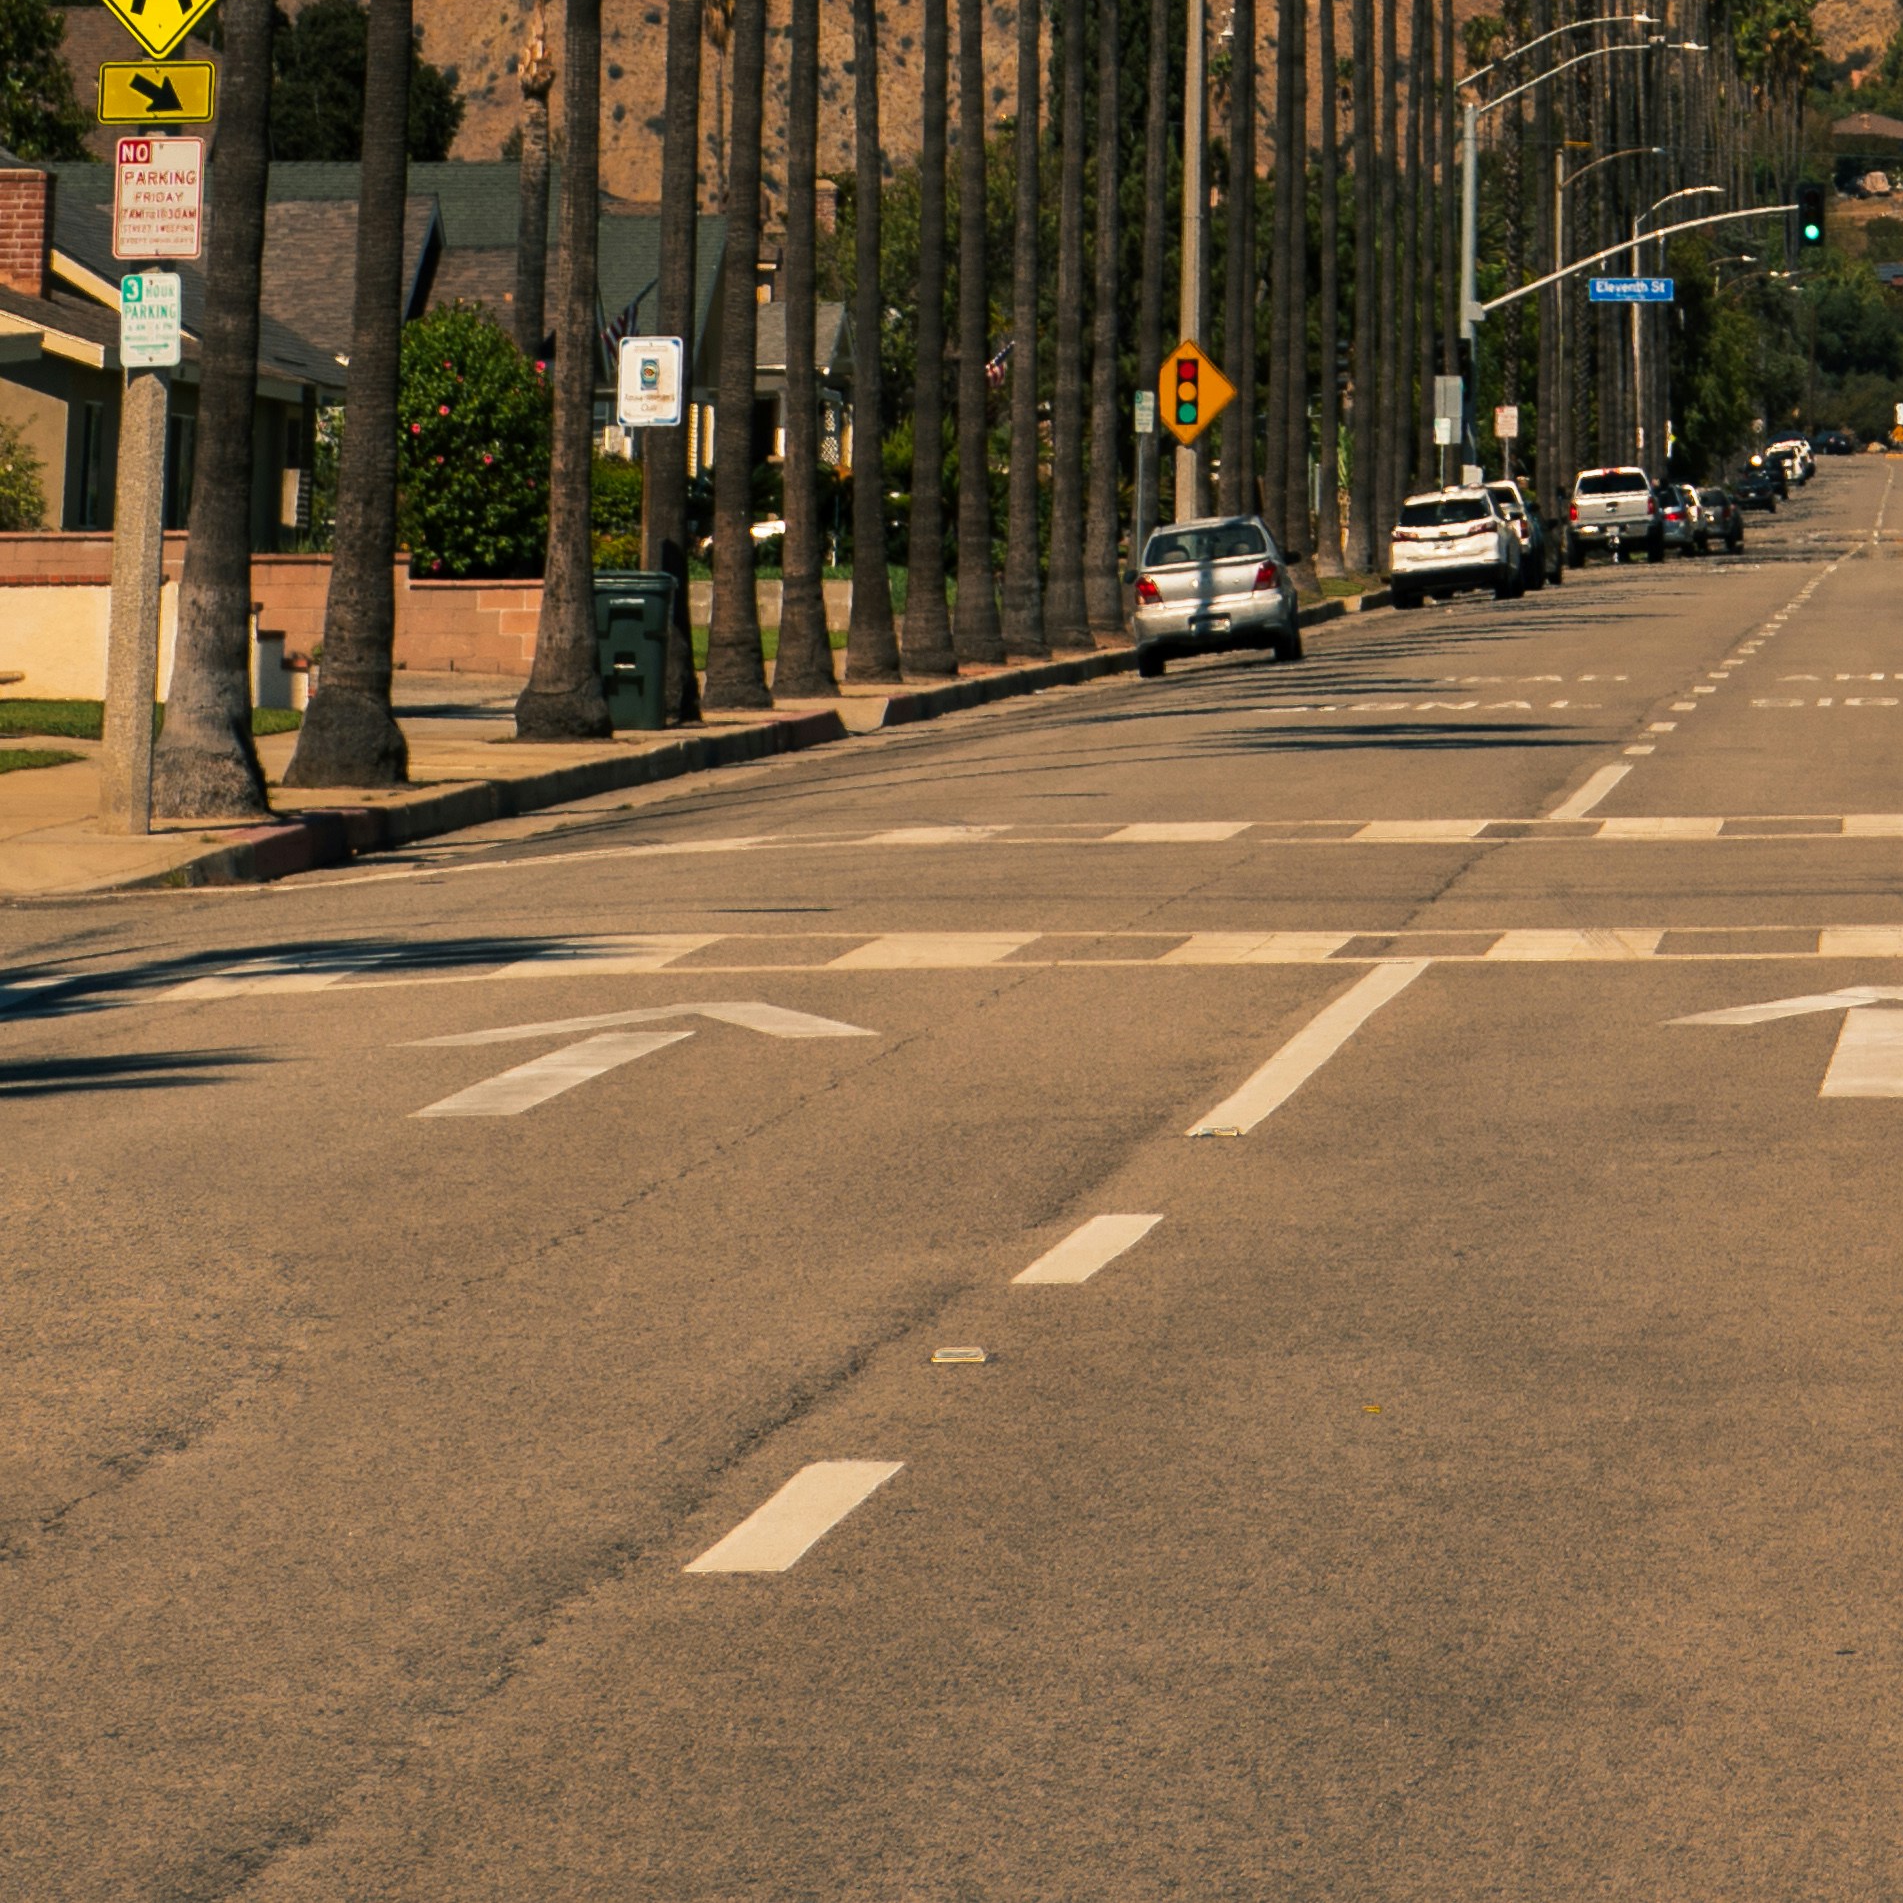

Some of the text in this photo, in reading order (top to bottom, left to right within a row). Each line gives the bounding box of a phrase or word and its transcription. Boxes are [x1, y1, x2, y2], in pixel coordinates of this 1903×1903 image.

[122, 143, 149, 162] NO
[124, 170, 196, 185] PARKING
[134, 192, 184, 202] FRIDAY
[126, 279, 175, 301] 3 HOUR
[1596, 280, 1666, 293] Eleventh St
[124, 304, 176, 320] PARKING
